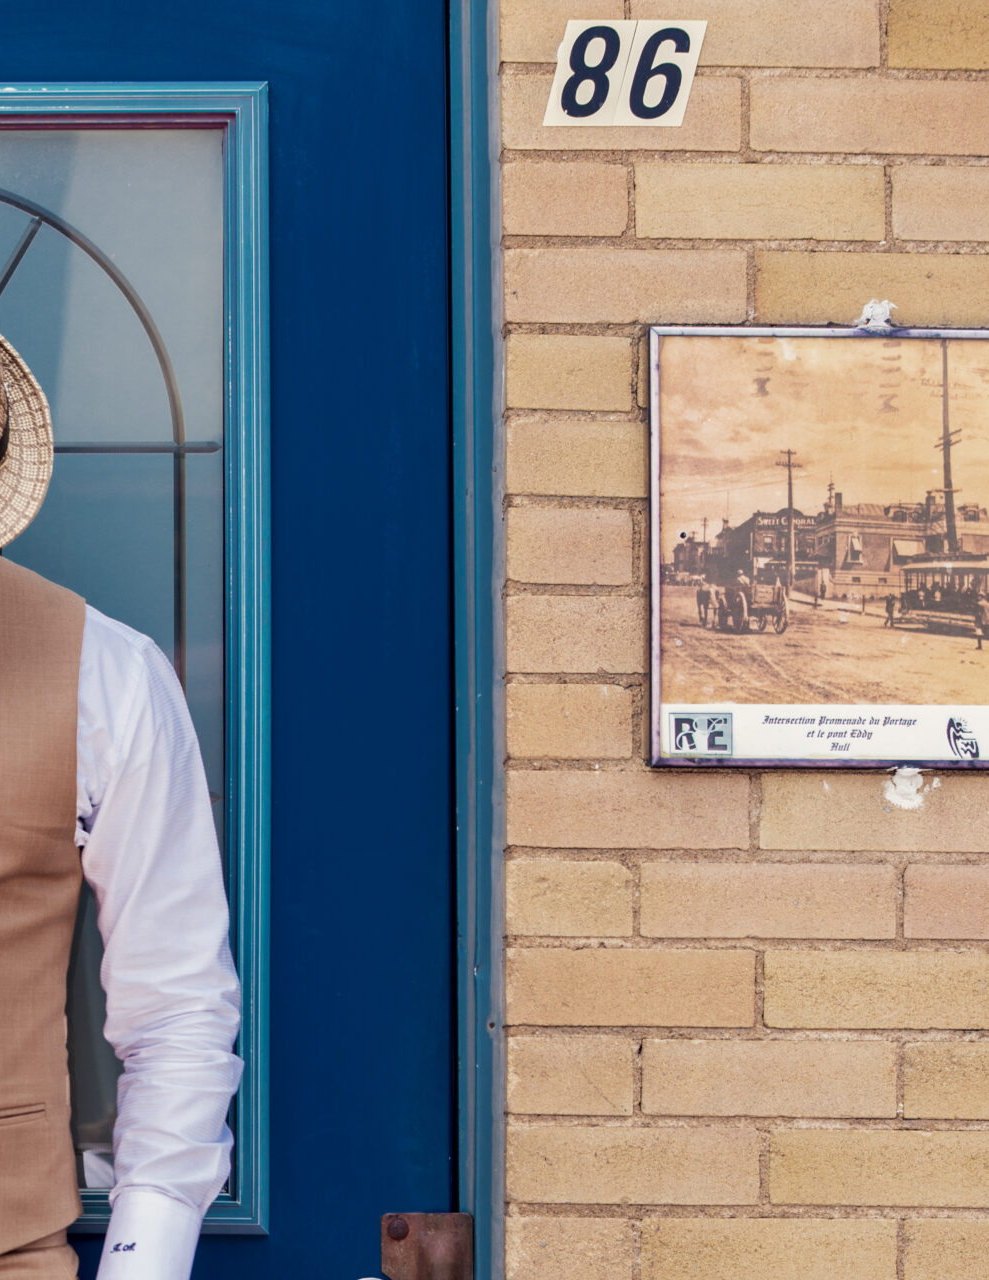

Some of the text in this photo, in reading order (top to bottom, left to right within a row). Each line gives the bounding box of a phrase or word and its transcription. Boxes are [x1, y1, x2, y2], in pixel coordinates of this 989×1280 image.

[560, 25, 691, 120] 86
[762, 715, 917, 727] Intersection Promenade du Portage
[806, 729, 873, 740] et le pont Eddy
[830, 742, 850, 751] Hull
